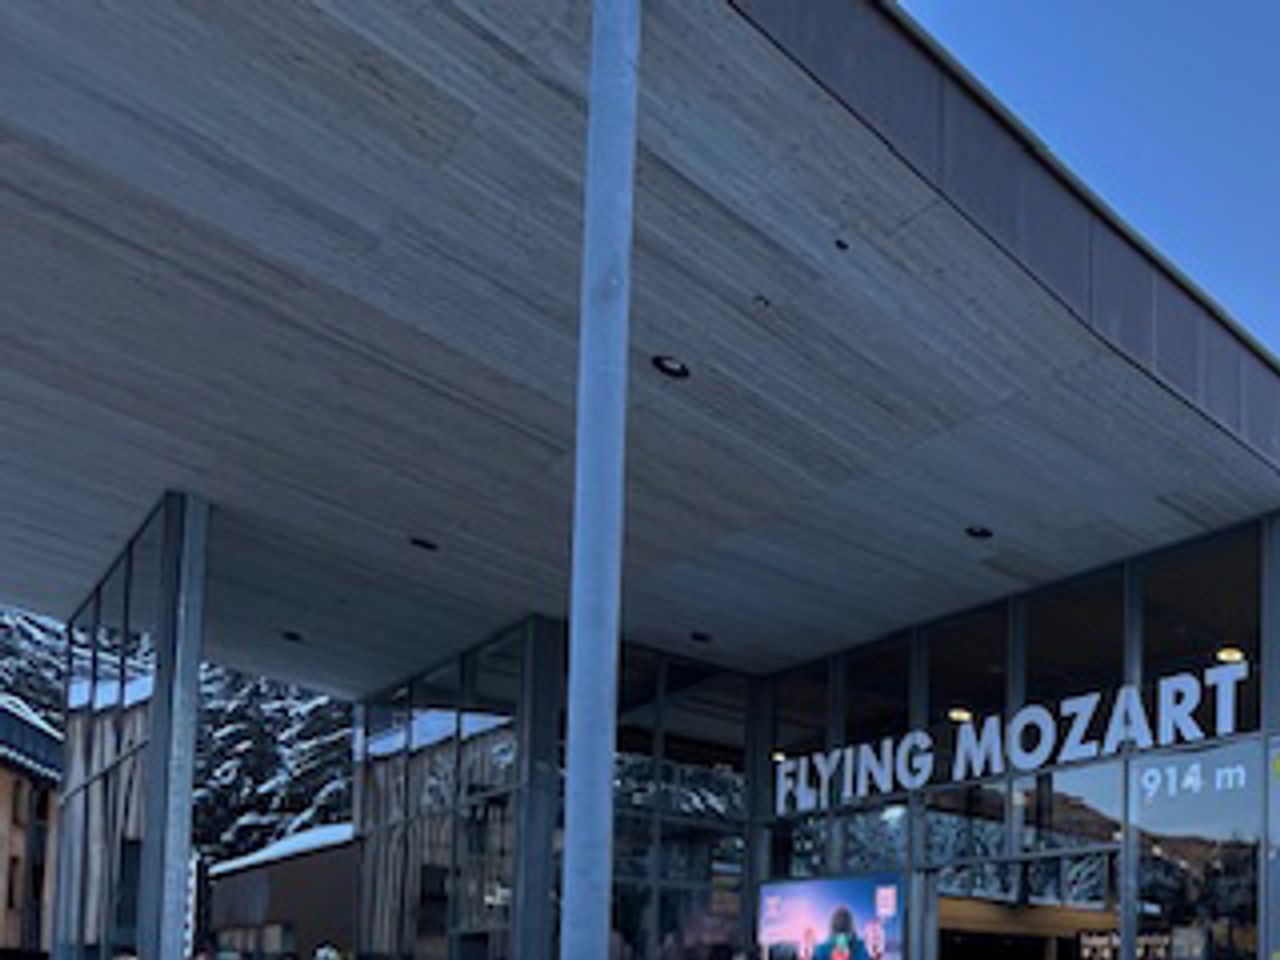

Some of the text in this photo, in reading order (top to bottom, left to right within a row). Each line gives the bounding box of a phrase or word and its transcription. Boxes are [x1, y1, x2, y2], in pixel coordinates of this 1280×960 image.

[775, 661, 1249, 816] FLYING MOZART
[1142, 762, 1246, 799] 914 m
